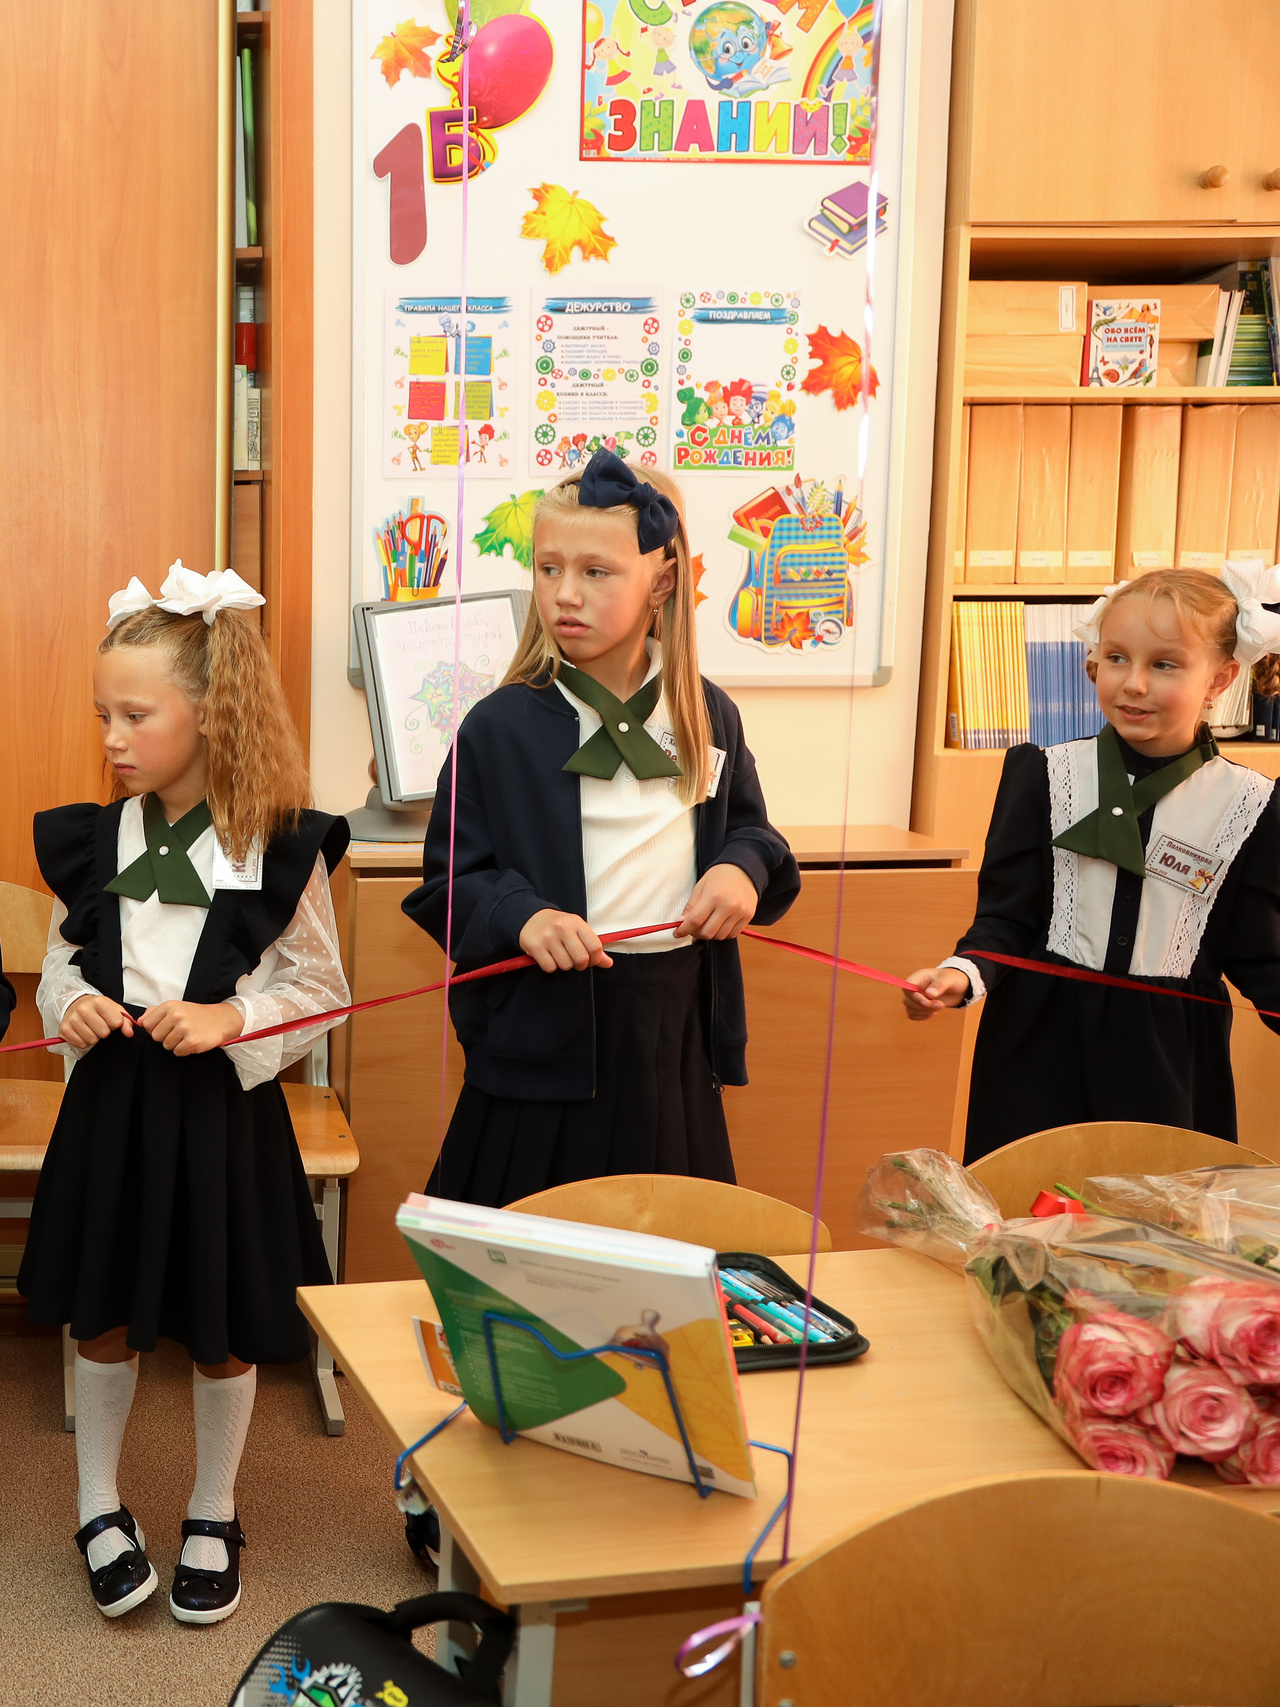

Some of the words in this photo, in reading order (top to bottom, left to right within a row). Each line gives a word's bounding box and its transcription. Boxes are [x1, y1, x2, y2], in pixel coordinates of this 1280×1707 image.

[606, 97, 849, 156] ЗНАНИЙ!
[404, 304, 436, 312] ПРАВИЛА
[438, 304, 463, 312] НАШЕГ
[467, 304, 495, 312] КЛАССА
[565, 301, 631, 313] ДЕЖУРСТВО
[709, 311, 771, 320] ПОЗДРАВЛЯЕМ
[1124, 326, 1145, 334] ВСЁМ
[690, 425, 709, 448] С
[714, 426, 771, 446] ДНЁМ
[676, 447, 794, 466] РОЖДЕНИЯ!
[1158, 852, 1192, 875] Юля
